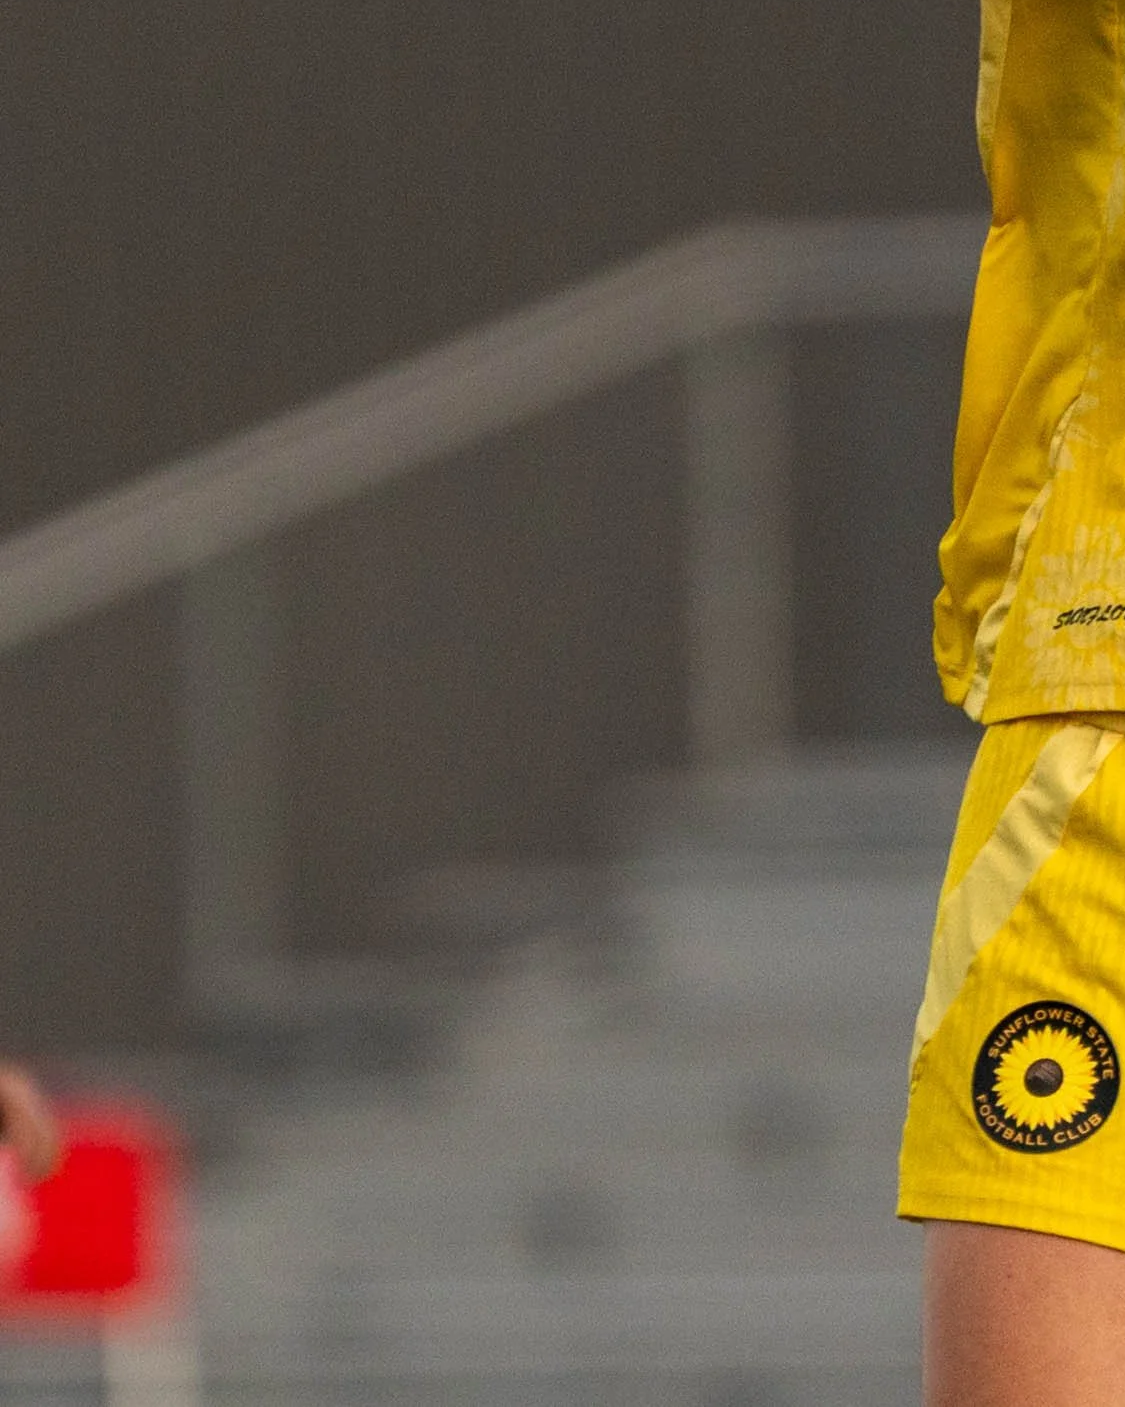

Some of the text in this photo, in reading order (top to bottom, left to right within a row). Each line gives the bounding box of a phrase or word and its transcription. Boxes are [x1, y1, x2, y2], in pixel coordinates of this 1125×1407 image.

[987, 1007, 1115, 1081] SUNFLOWER STATE
[976, 1094, 1102, 1146] FOOTBALL CLUB
